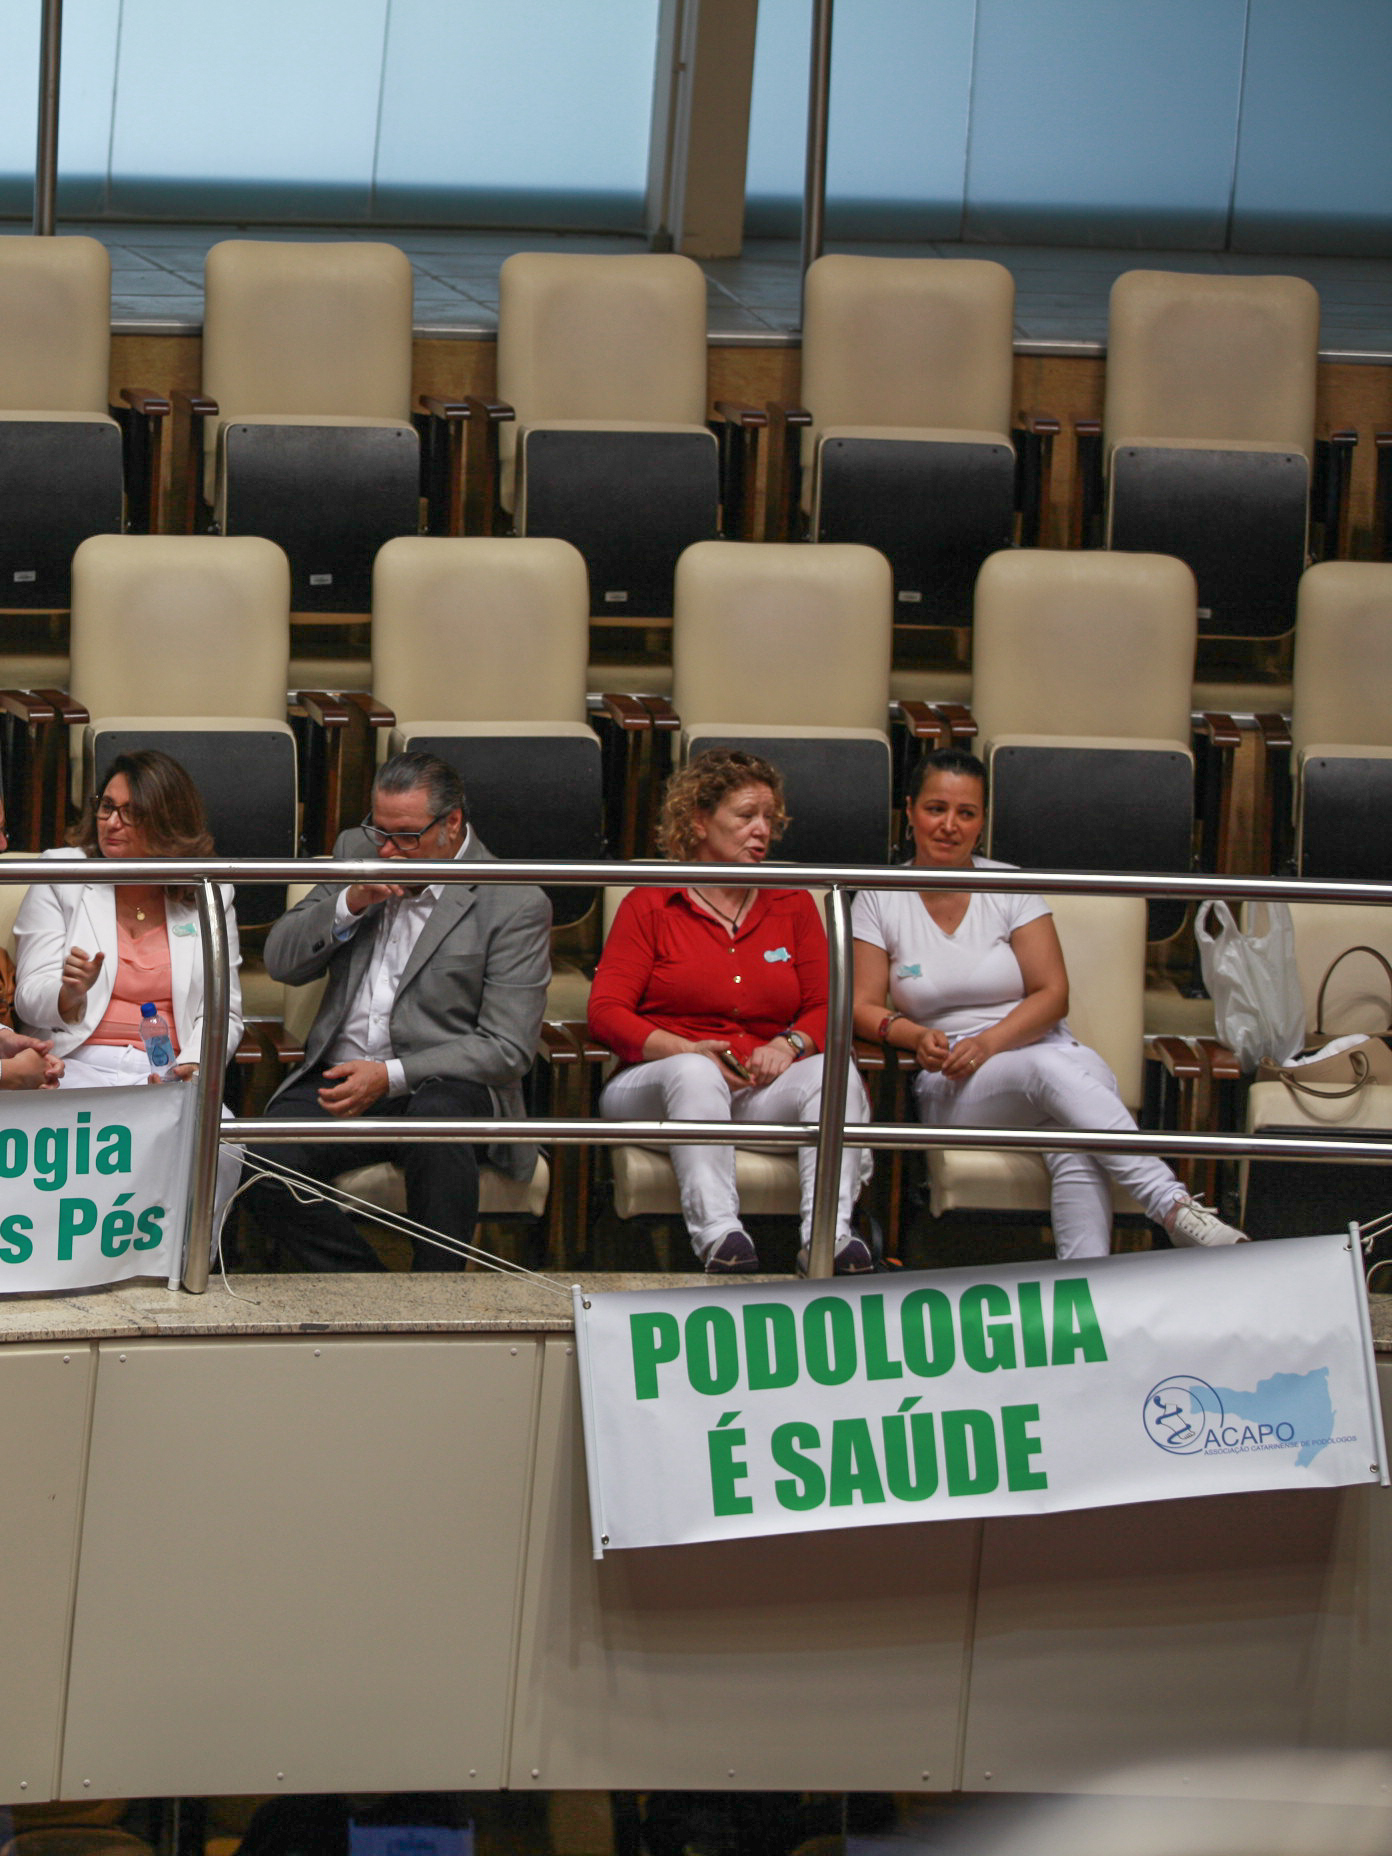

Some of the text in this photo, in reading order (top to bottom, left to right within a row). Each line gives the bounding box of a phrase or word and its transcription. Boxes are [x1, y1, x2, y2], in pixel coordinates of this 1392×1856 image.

[57, 1192, 165, 1261] Pés
[629, 1278, 1108, 1401] PODOLOGIA
[707, 1396, 1049, 1517] É SAÚDE
[1204, 1421, 1295, 1449] ACAPO
